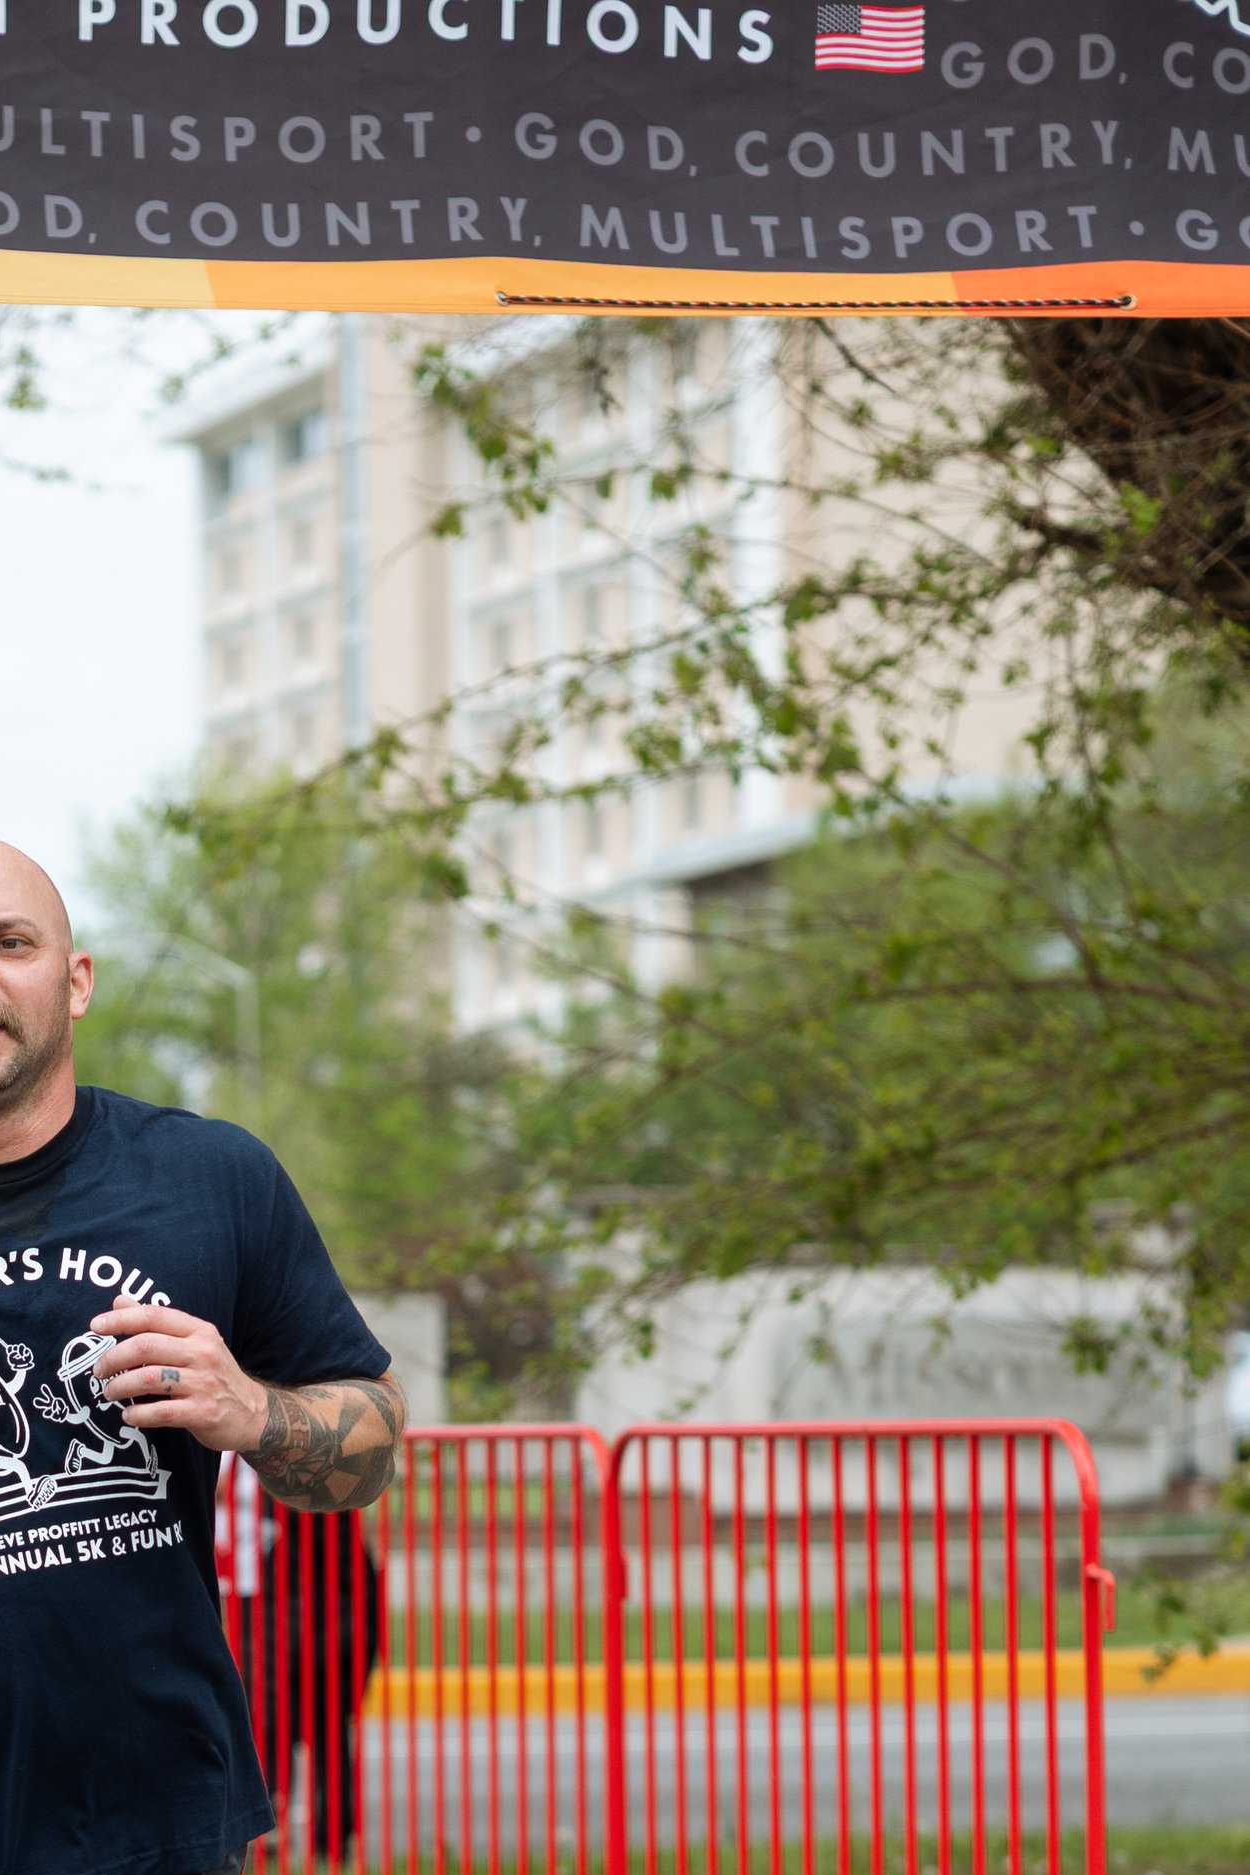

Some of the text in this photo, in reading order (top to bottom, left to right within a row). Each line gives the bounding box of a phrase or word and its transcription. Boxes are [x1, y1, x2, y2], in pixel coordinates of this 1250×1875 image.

[78, 0, 774, 65] PRODUCTIONS
[940, 33, 1250, 95] GOD, CO
[514, 112, 698, 177] GOD,
[734, 120, 1132, 178] COUNTRY,
[135, 196, 541, 248] COUNTRY,
[579, 203, 1098, 260] MULTISPORT
[1175, 209, 1250, 251] G
[59, 1247, 171, 1307] HOU
[27, 1518, 101, 1544] PROFFITT
[104, 1509, 158, 1531] LEGACY
[76, 1537, 107, 1562] 5K
[111, 1535, 127, 1556] &
[130, 1526, 173, 1552] FUN
